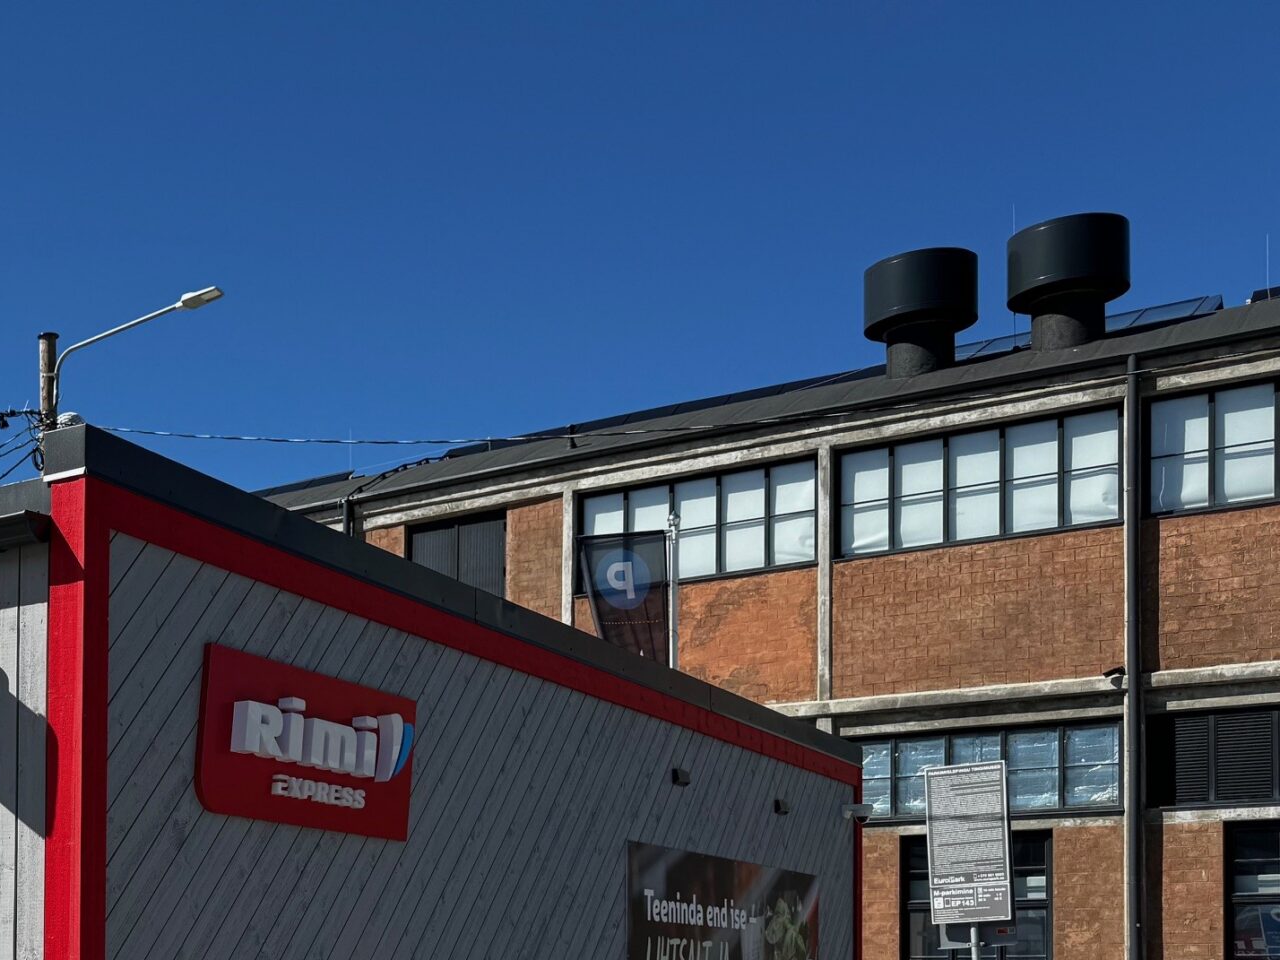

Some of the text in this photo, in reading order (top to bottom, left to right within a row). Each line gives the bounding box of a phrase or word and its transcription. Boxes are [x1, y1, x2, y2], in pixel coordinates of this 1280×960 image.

[230, 696, 378, 778] Rimi
[271, 774, 366, 809] EXPRESS
[644, 889, 703, 927] Teeninda
[706, 898, 727, 929] end
[730, 899, 746, 930] ise
